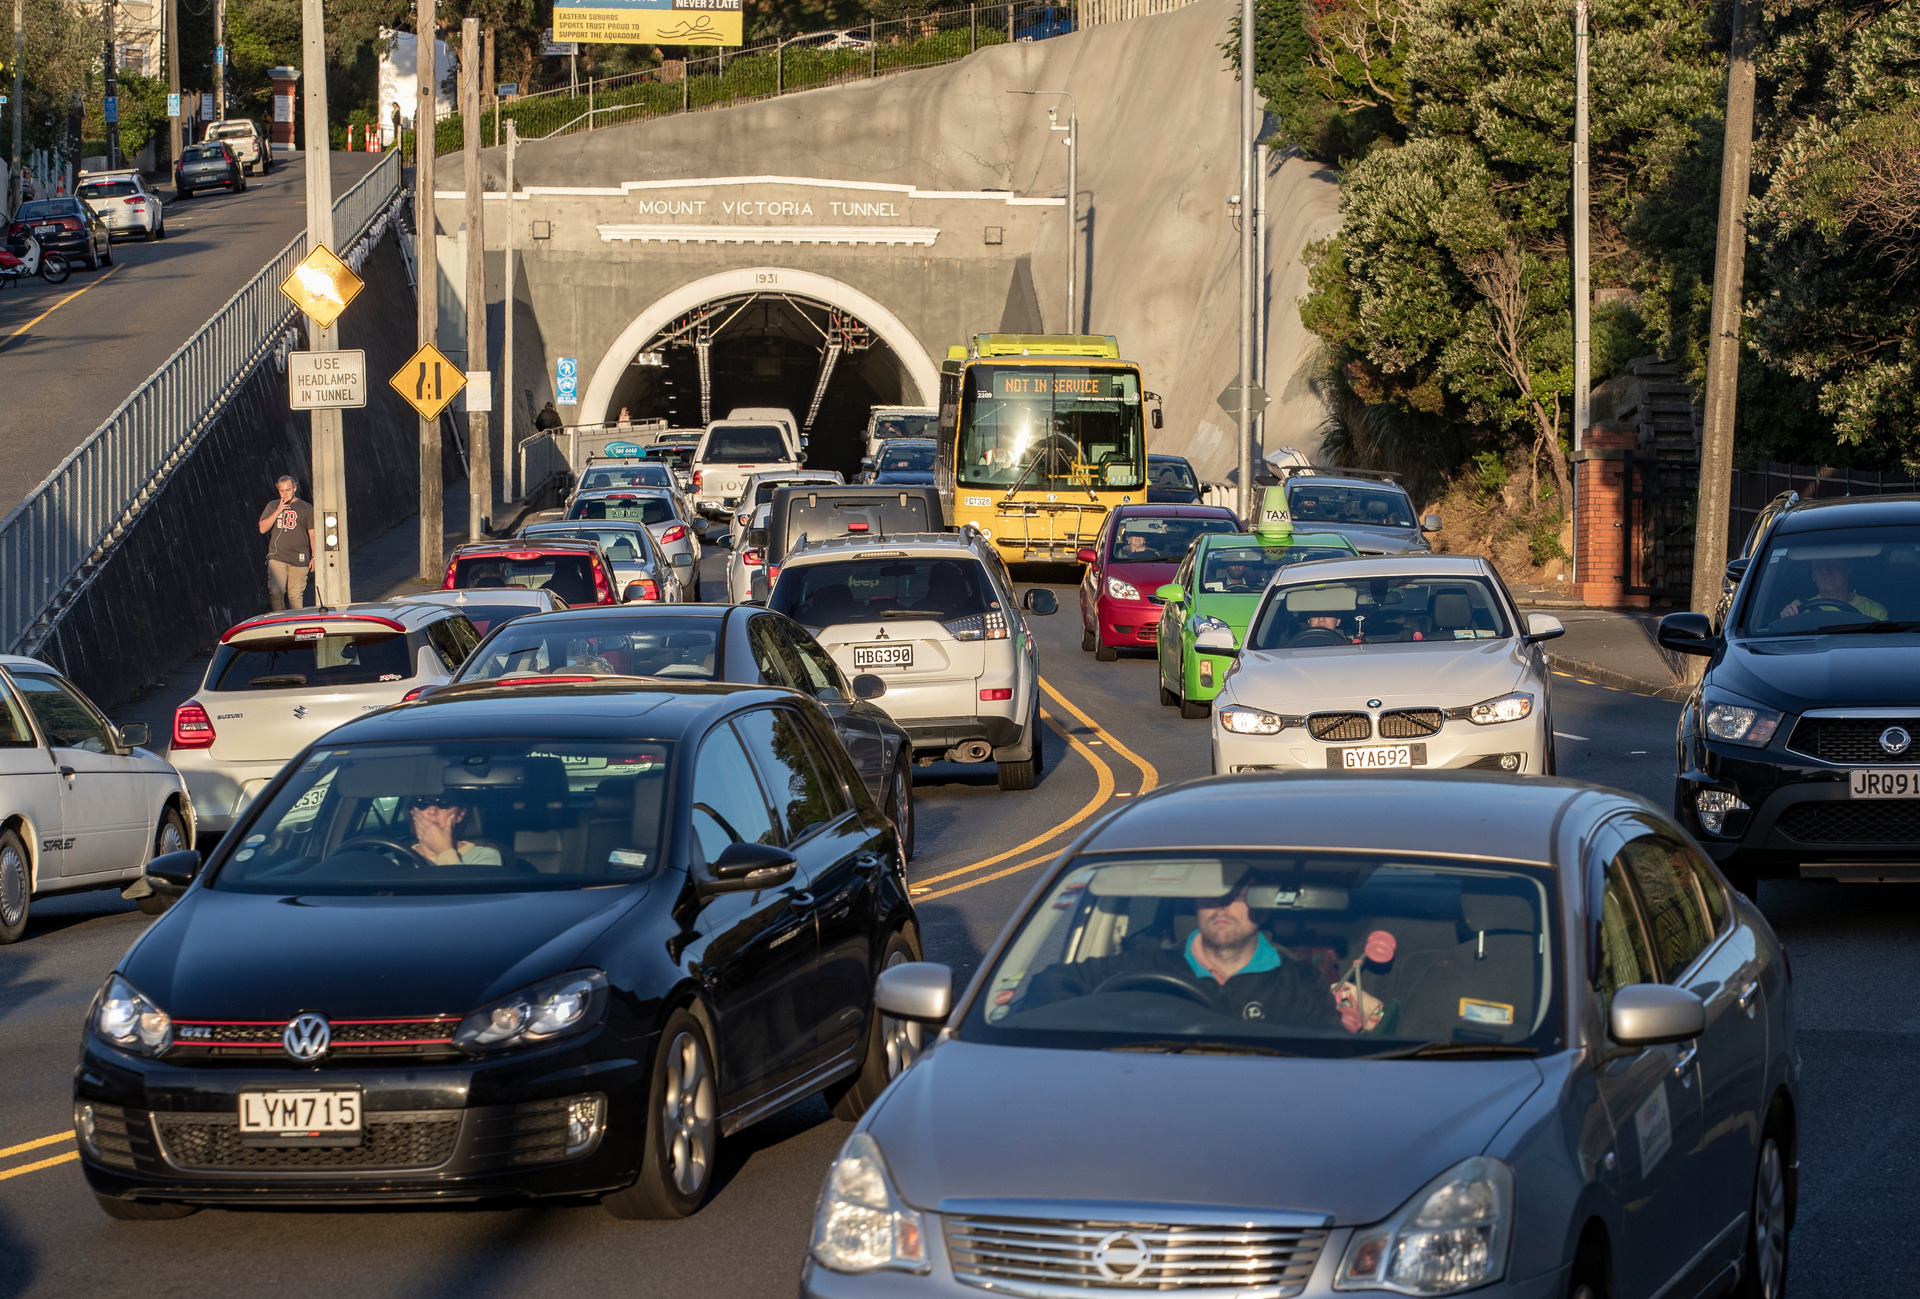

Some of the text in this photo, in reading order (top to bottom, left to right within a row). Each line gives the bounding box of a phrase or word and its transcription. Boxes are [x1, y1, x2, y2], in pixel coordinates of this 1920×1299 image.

[676, 0, 739, 9] NEVER 2 LATE
[588, 13, 619, 21] SUBURBS
[585, 22, 605, 30] TRUST
[607, 23, 629, 31] PROUD
[631, 23, 640, 31] TO
[559, 31, 589, 39] SUPPORT
[604, 32, 640, 40] AQUADOME
[639, 201, 900, 217] MOUNT VICTORIA TUNNEL
[755, 274, 778, 284] 1931
[314, 358, 340, 370] USE
[298, 373, 357, 387] HEADLAMPS
[1005, 378, 1099, 393] NOT IN SERVICE
[301, 388, 354, 402] IN TUNNEL
[1266, 510, 1289, 520] TAXI
[857, 648, 910, 664] HBG390
[217, 712, 244, 720] SUZUKI
[1346, 749, 1408, 767] GYA692
[1854, 773, 1920, 795] JRQ91
[179, 1026, 213, 1038] GTI
[245, 1097, 355, 1128] LYM715
